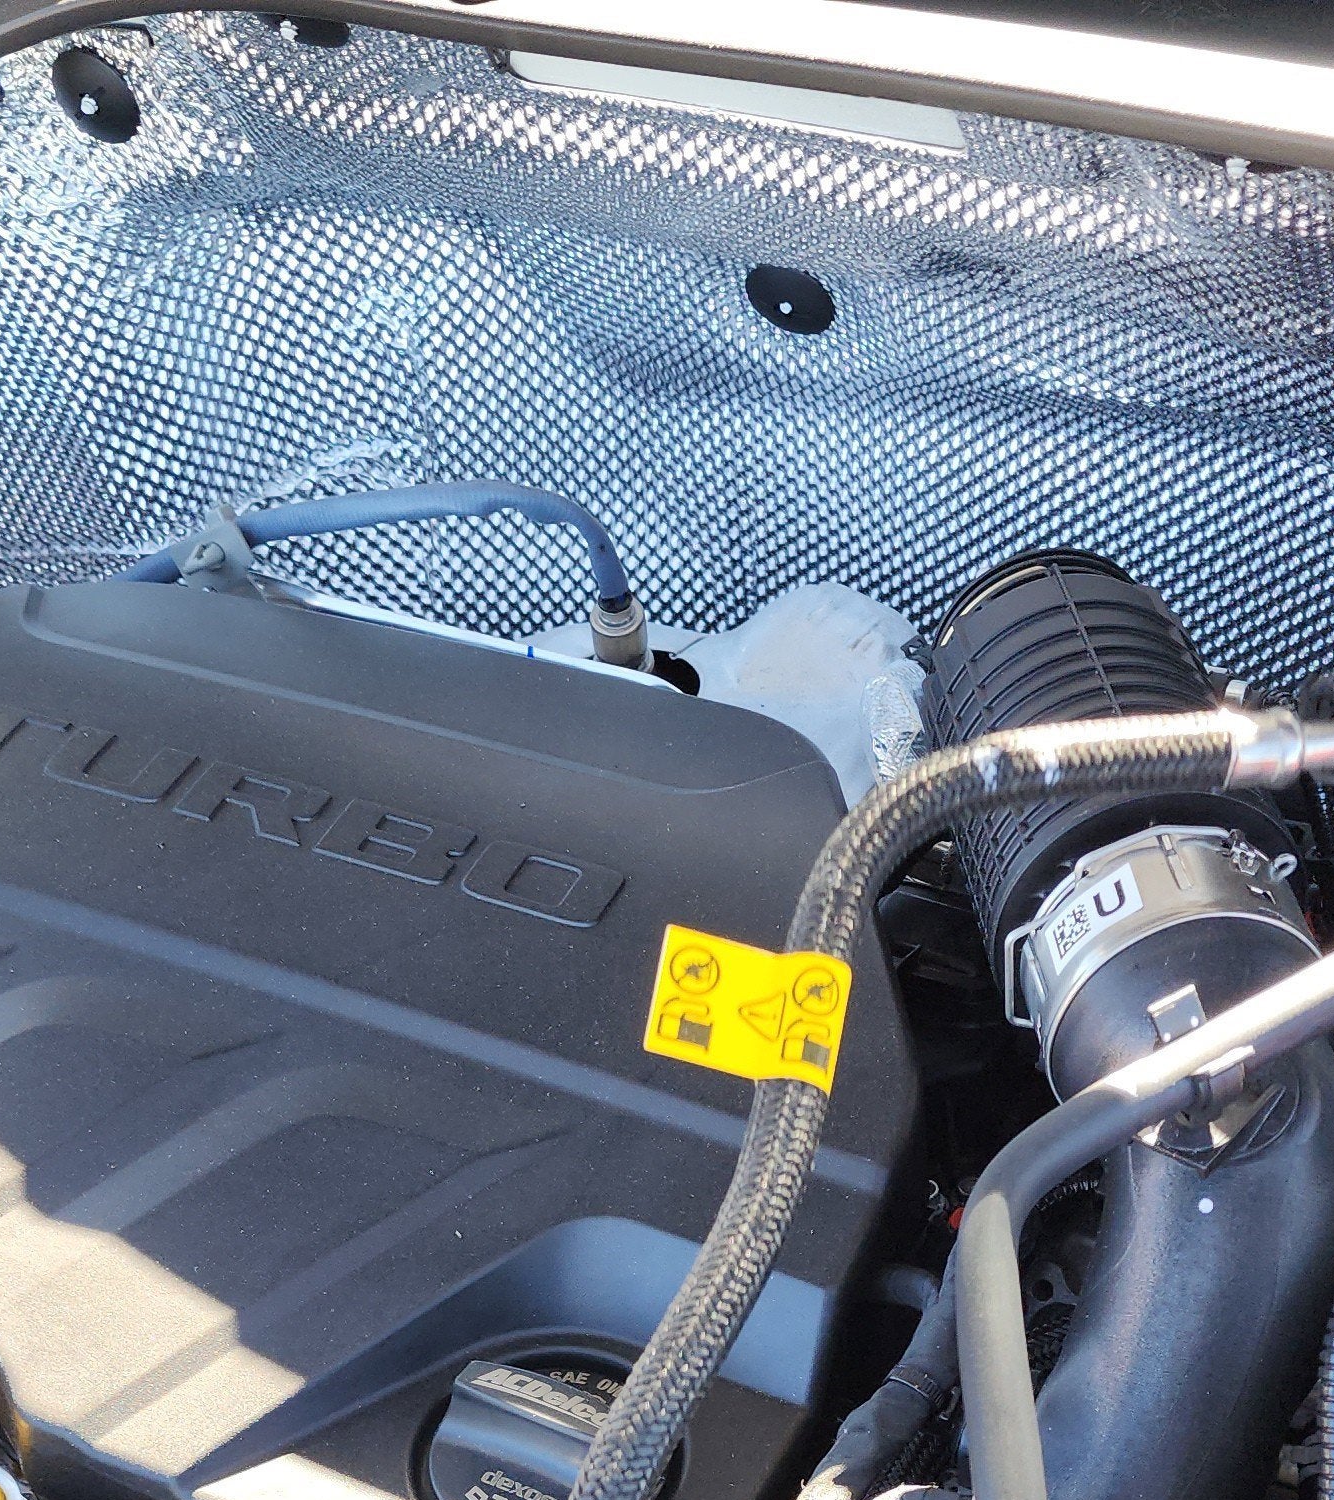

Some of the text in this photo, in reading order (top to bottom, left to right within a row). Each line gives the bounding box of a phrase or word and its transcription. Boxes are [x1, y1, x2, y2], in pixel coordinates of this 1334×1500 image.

[1093, 879, 1125, 917] U
[550, 1371, 625, 1398] SAE 0W
